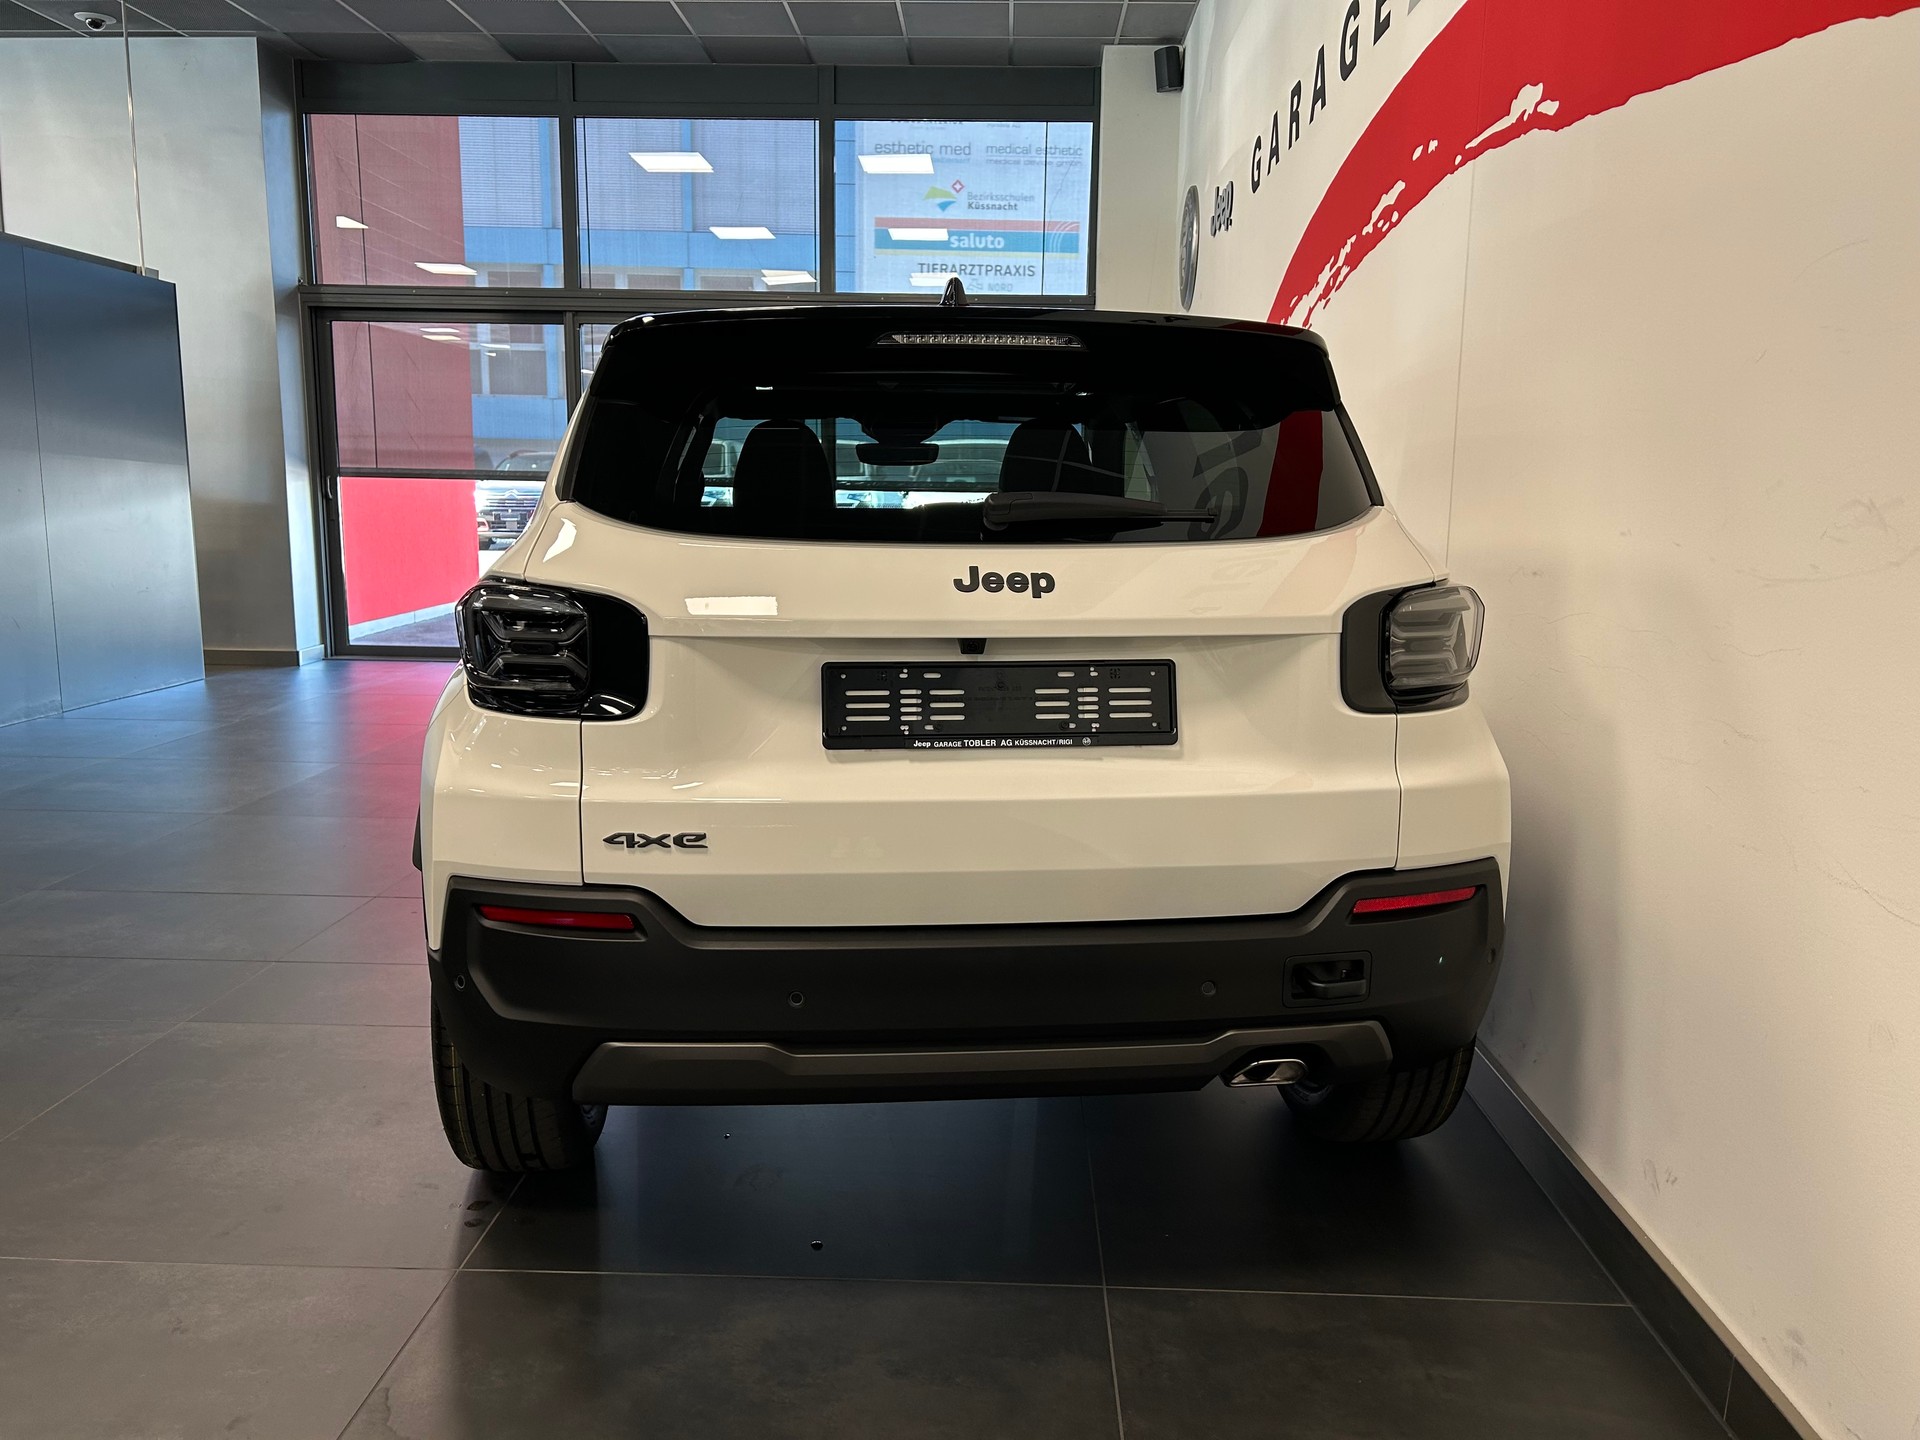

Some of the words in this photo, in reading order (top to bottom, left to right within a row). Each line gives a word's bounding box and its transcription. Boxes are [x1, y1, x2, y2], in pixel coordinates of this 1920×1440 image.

[874, 140, 934, 155] esthetic
[939, 141, 971, 156] med
[985, 143, 1032, 155] medical
[1035, 145, 1083, 157] esthetic
[967, 191, 1035, 203] Bezirksschulen
[967, 200, 1019, 211] Küssnacht
[949, 232, 1005, 249] saluto
[918, 262, 1036, 277] TIERARZTPRAXIS
[953, 565, 1056, 599] Jeep
[913, 740, 931, 749] Jeep
[933, 740, 962, 748] GARAGE
[963, 739, 997, 747] TOBLER
[1000, 738, 1013, 747] AG
[1014, 738, 1073, 746] KÜSSNACHT/RIGI
[602, 831, 709, 849] 4xe
